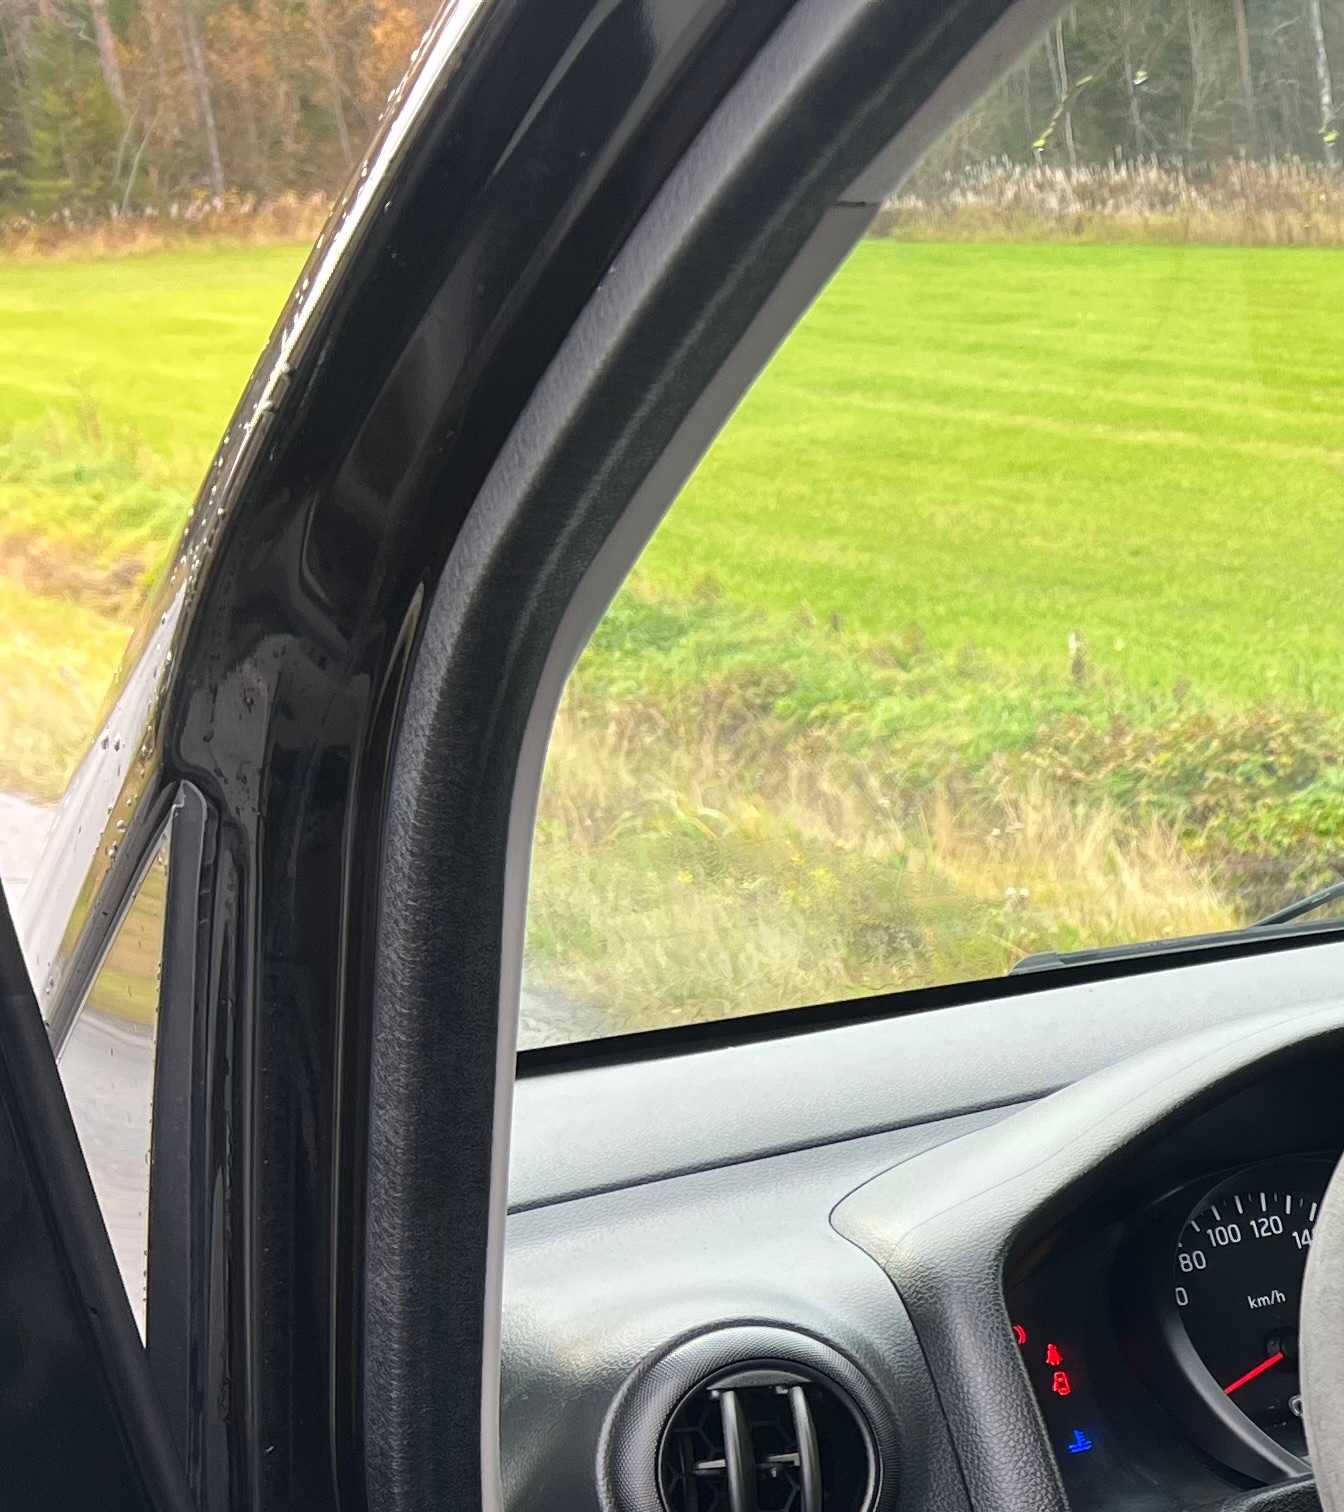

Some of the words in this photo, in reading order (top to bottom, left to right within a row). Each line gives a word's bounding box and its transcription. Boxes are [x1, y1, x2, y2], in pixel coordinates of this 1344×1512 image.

[1206, 1223, 1242, 1248] 100
[1250, 1215, 1284, 1239] 120
[1291, 1229, 1315, 1250] 14
[1178, 1250, 1208, 1273] 80
[1247, 1289, 1286, 1309] km/h
